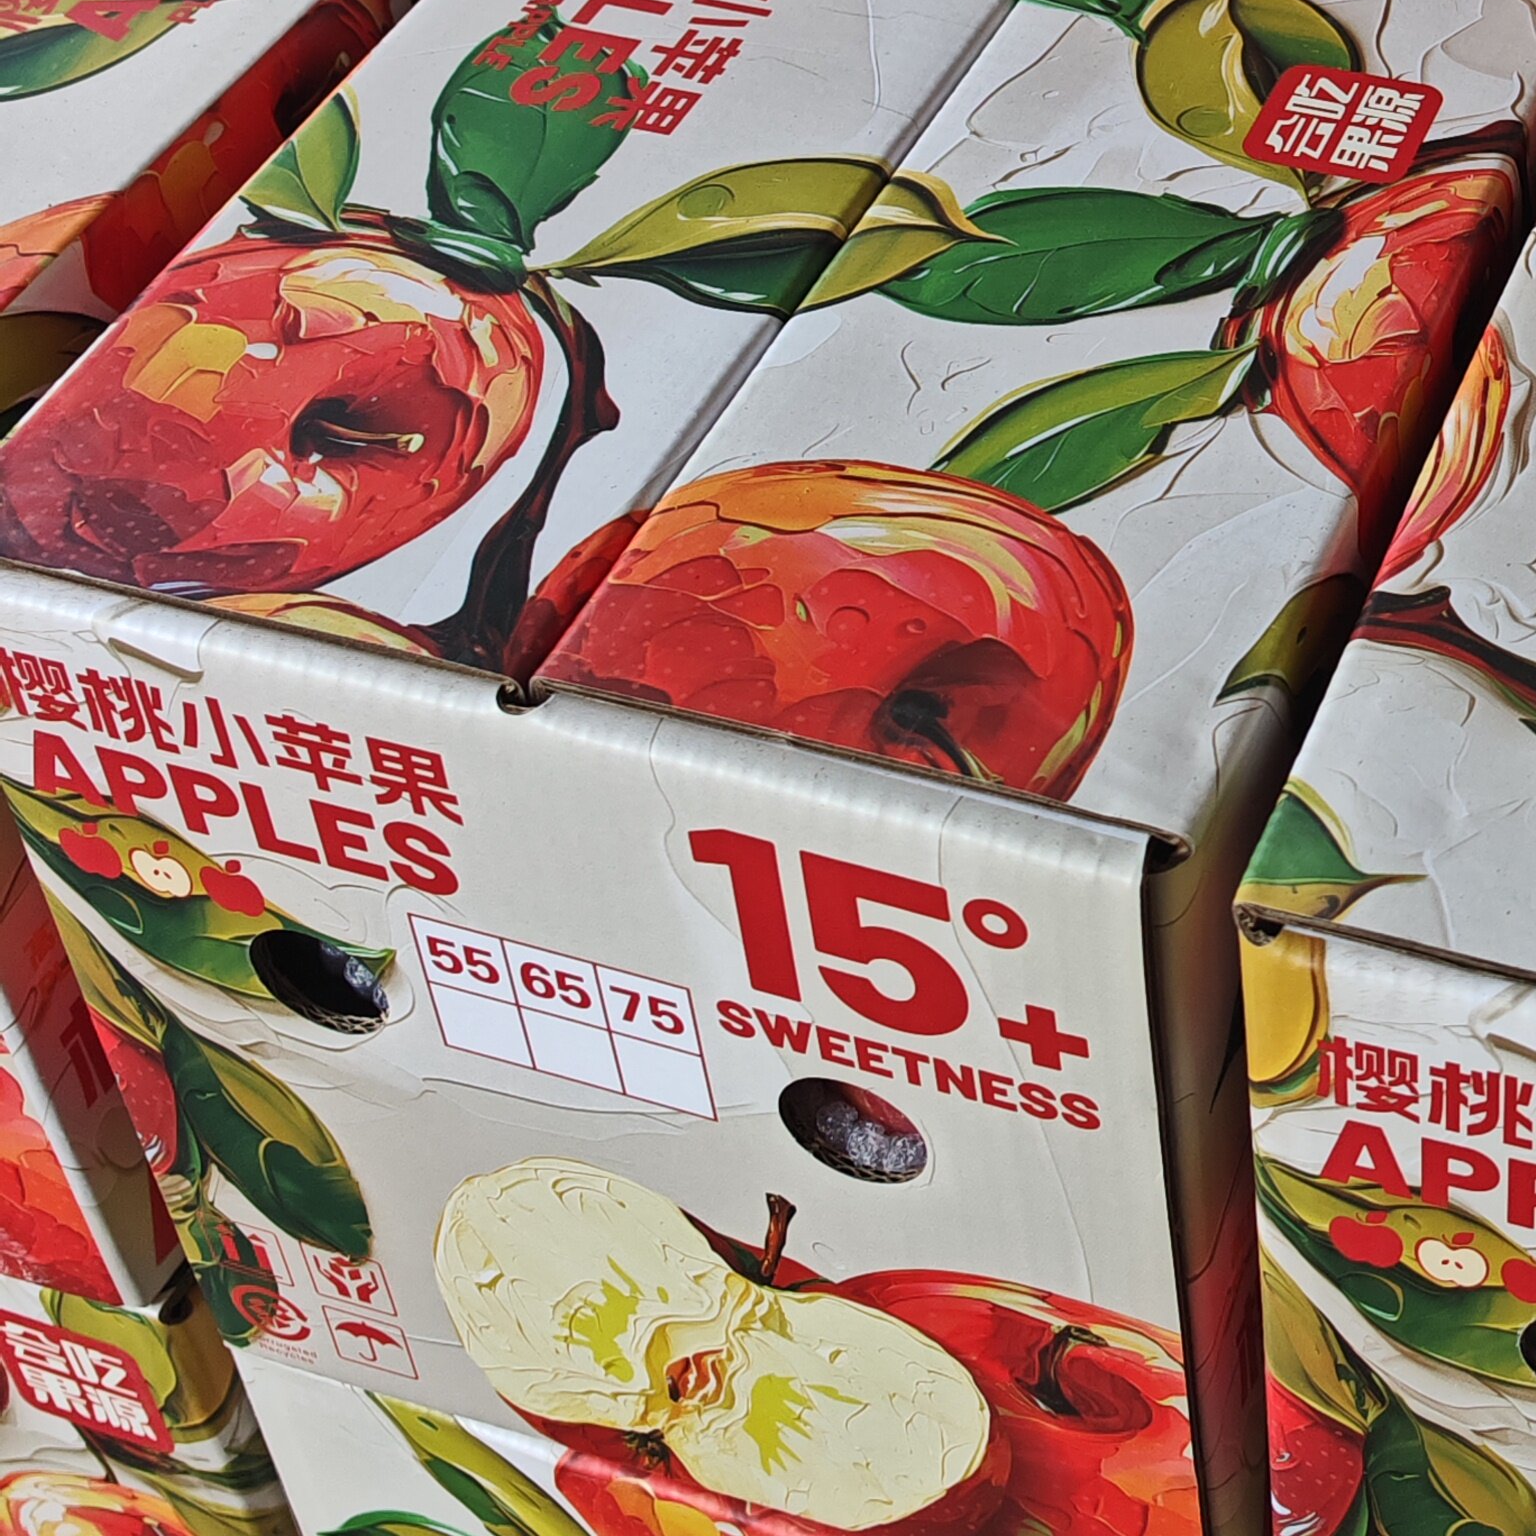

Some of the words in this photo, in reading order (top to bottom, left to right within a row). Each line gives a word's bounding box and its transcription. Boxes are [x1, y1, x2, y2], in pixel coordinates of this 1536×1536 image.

[0, 646, 464, 826] 樱桃小苹果
[32, 729, 459, 896] APPLES
[425, 934, 500, 985] 55
[519, 961, 593, 1010] 65
[609, 985, 685, 1036] 75
[715, 999, 1102, 1131] SWEETNESS
